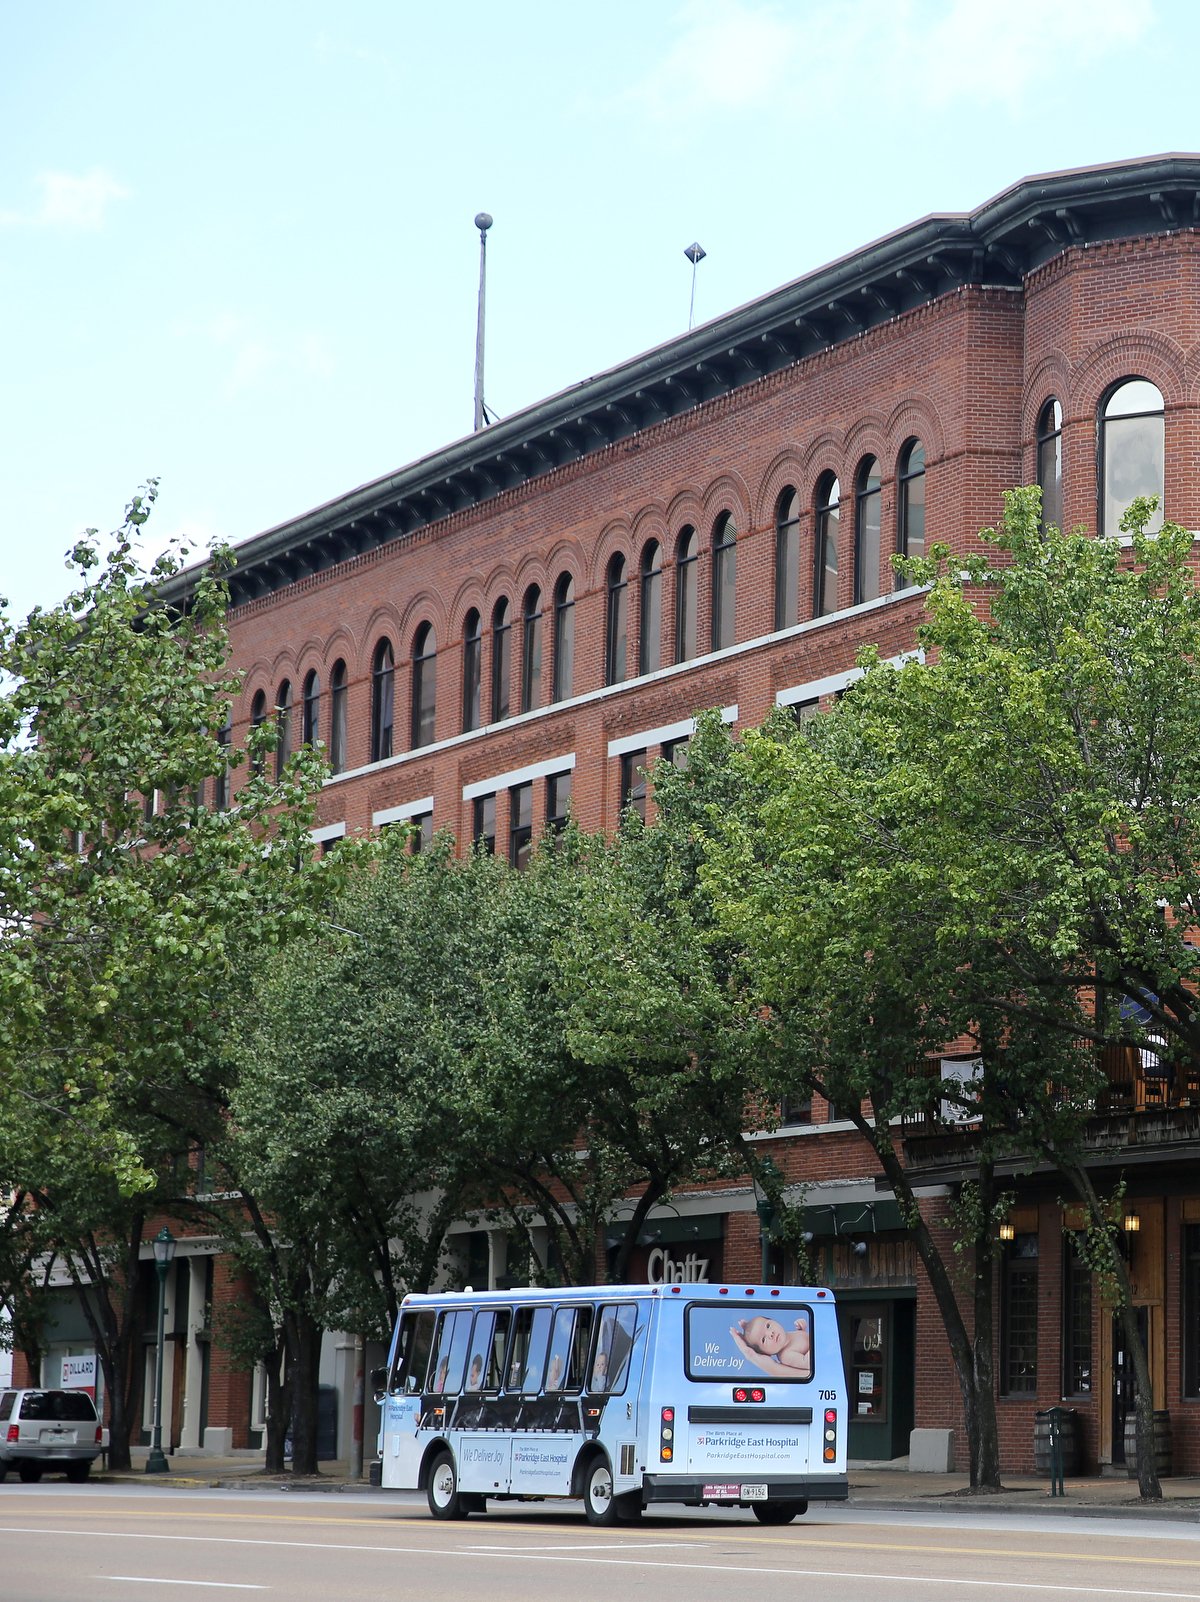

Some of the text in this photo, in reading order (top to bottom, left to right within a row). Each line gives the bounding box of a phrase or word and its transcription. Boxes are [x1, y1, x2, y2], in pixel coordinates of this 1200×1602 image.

[647, 1247, 710, 1284] Chattz
[704, 1342, 720, 1354] We
[69, 1361, 94, 1375] DILLARD
[693, 1355, 744, 1370] Deliver Joy
[818, 1389, 837, 1401] 705
[705, 1437, 799, 1449] Parkridge East Hospital
[463, 1448, 504, 1466] We Deliver Joy
[519, 1453, 568, 1465] Parkridge East Hospital
[706, 1451, 791, 1460] ParkridgeEastHospital.com
